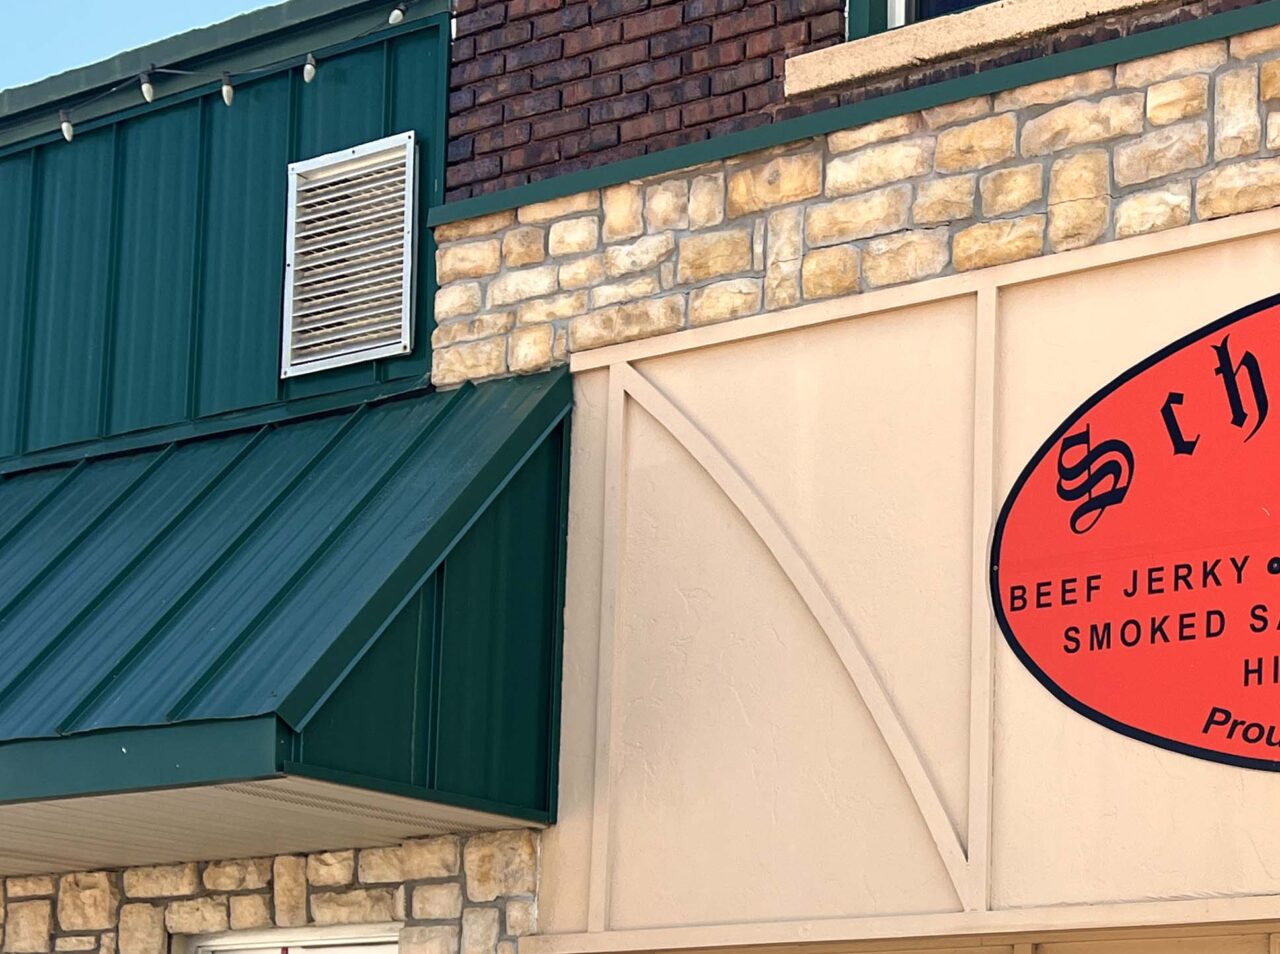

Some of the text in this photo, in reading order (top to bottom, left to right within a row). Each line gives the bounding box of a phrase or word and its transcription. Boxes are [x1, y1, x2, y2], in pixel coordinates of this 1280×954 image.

[1009, 573, 1103, 612] BEEF
[1122, 555, 1251, 598] JERKY
[1063, 608, 1227, 655] SMOKED
